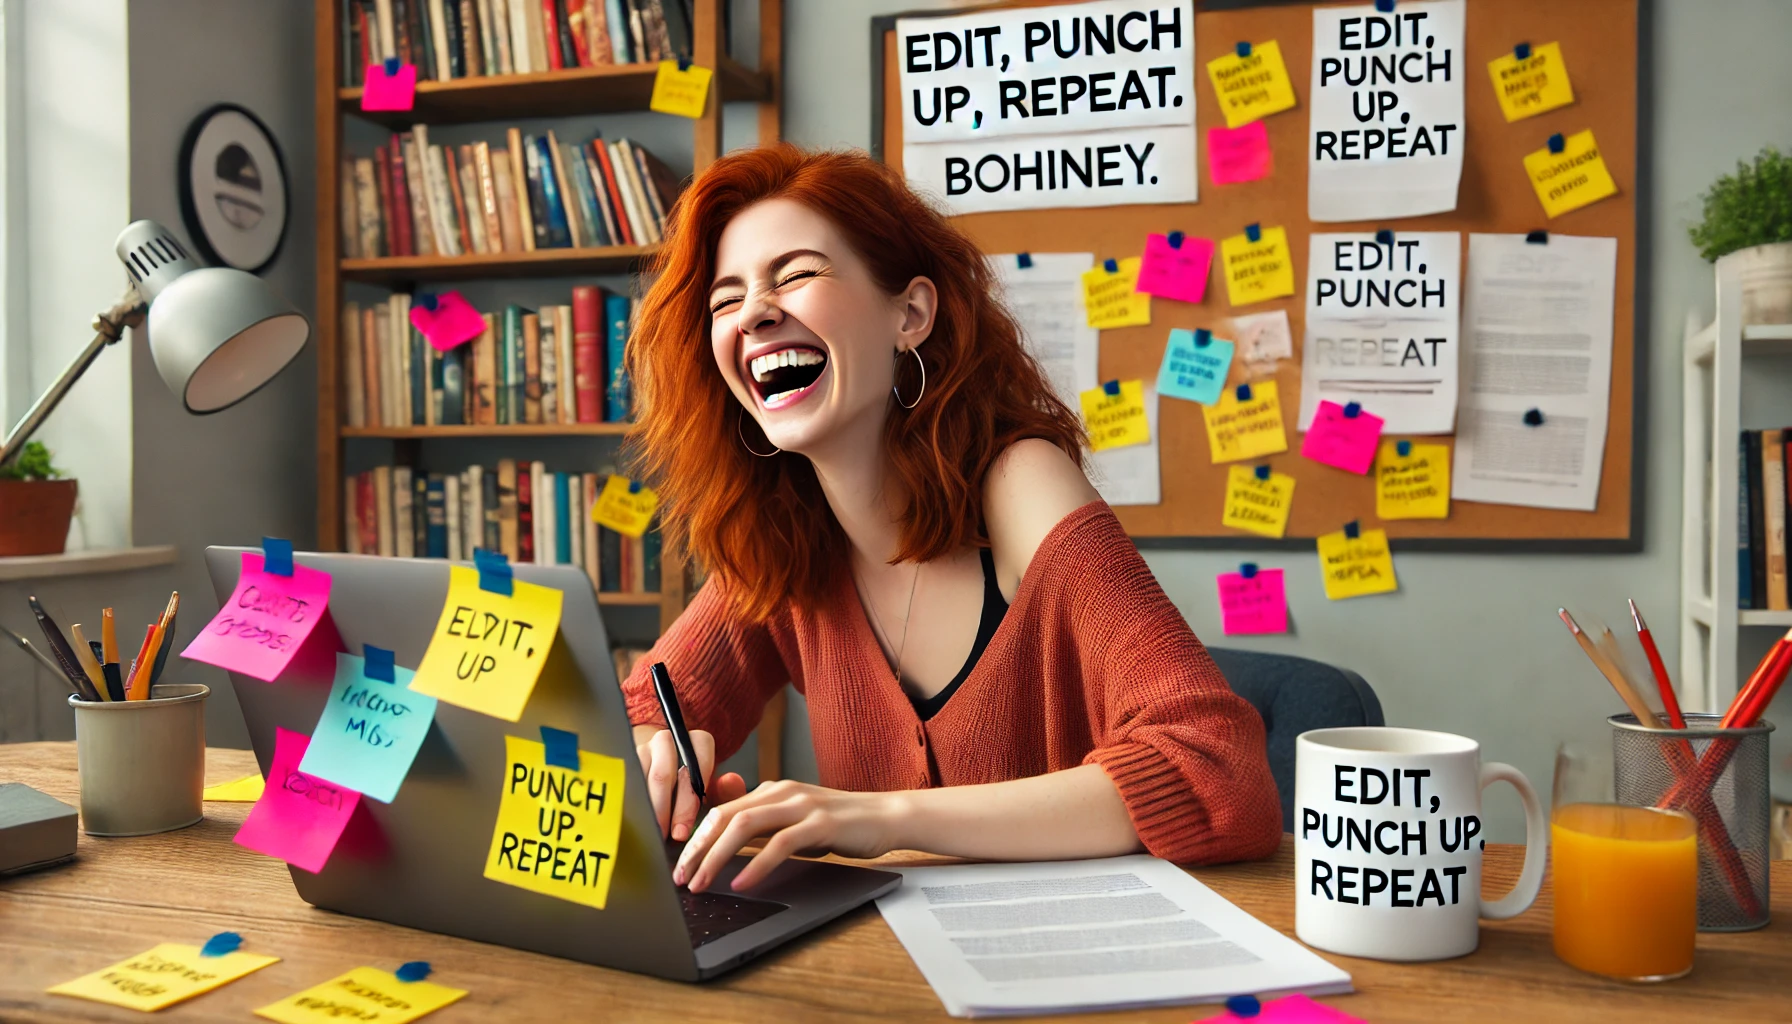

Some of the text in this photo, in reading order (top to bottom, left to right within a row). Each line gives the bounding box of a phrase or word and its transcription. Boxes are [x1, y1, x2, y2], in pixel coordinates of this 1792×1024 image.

[906, 7, 1181, 72] EDIT, PUNCH
[1321, 49, 1451, 87] PUNCH
[913, 85, 983, 129] UP,
[999, 67, 1183, 119] REPEAT.
[1315, 124, 1456, 160] REPEAT
[945, 142, 1158, 195] BOHINEY.
[1316, 278, 1445, 308] PUNCH
[1315, 338, 1447, 368] REPEAT
[456, 651, 496, 683] UP
[511, 763, 607, 814] PUNCH
[1335, 764, 1440, 814] EDIT,
[1303, 807, 1427, 856] PUNCH
[498, 832, 610, 888] REPEAT
[1311, 859, 1467, 908] REPEAT
